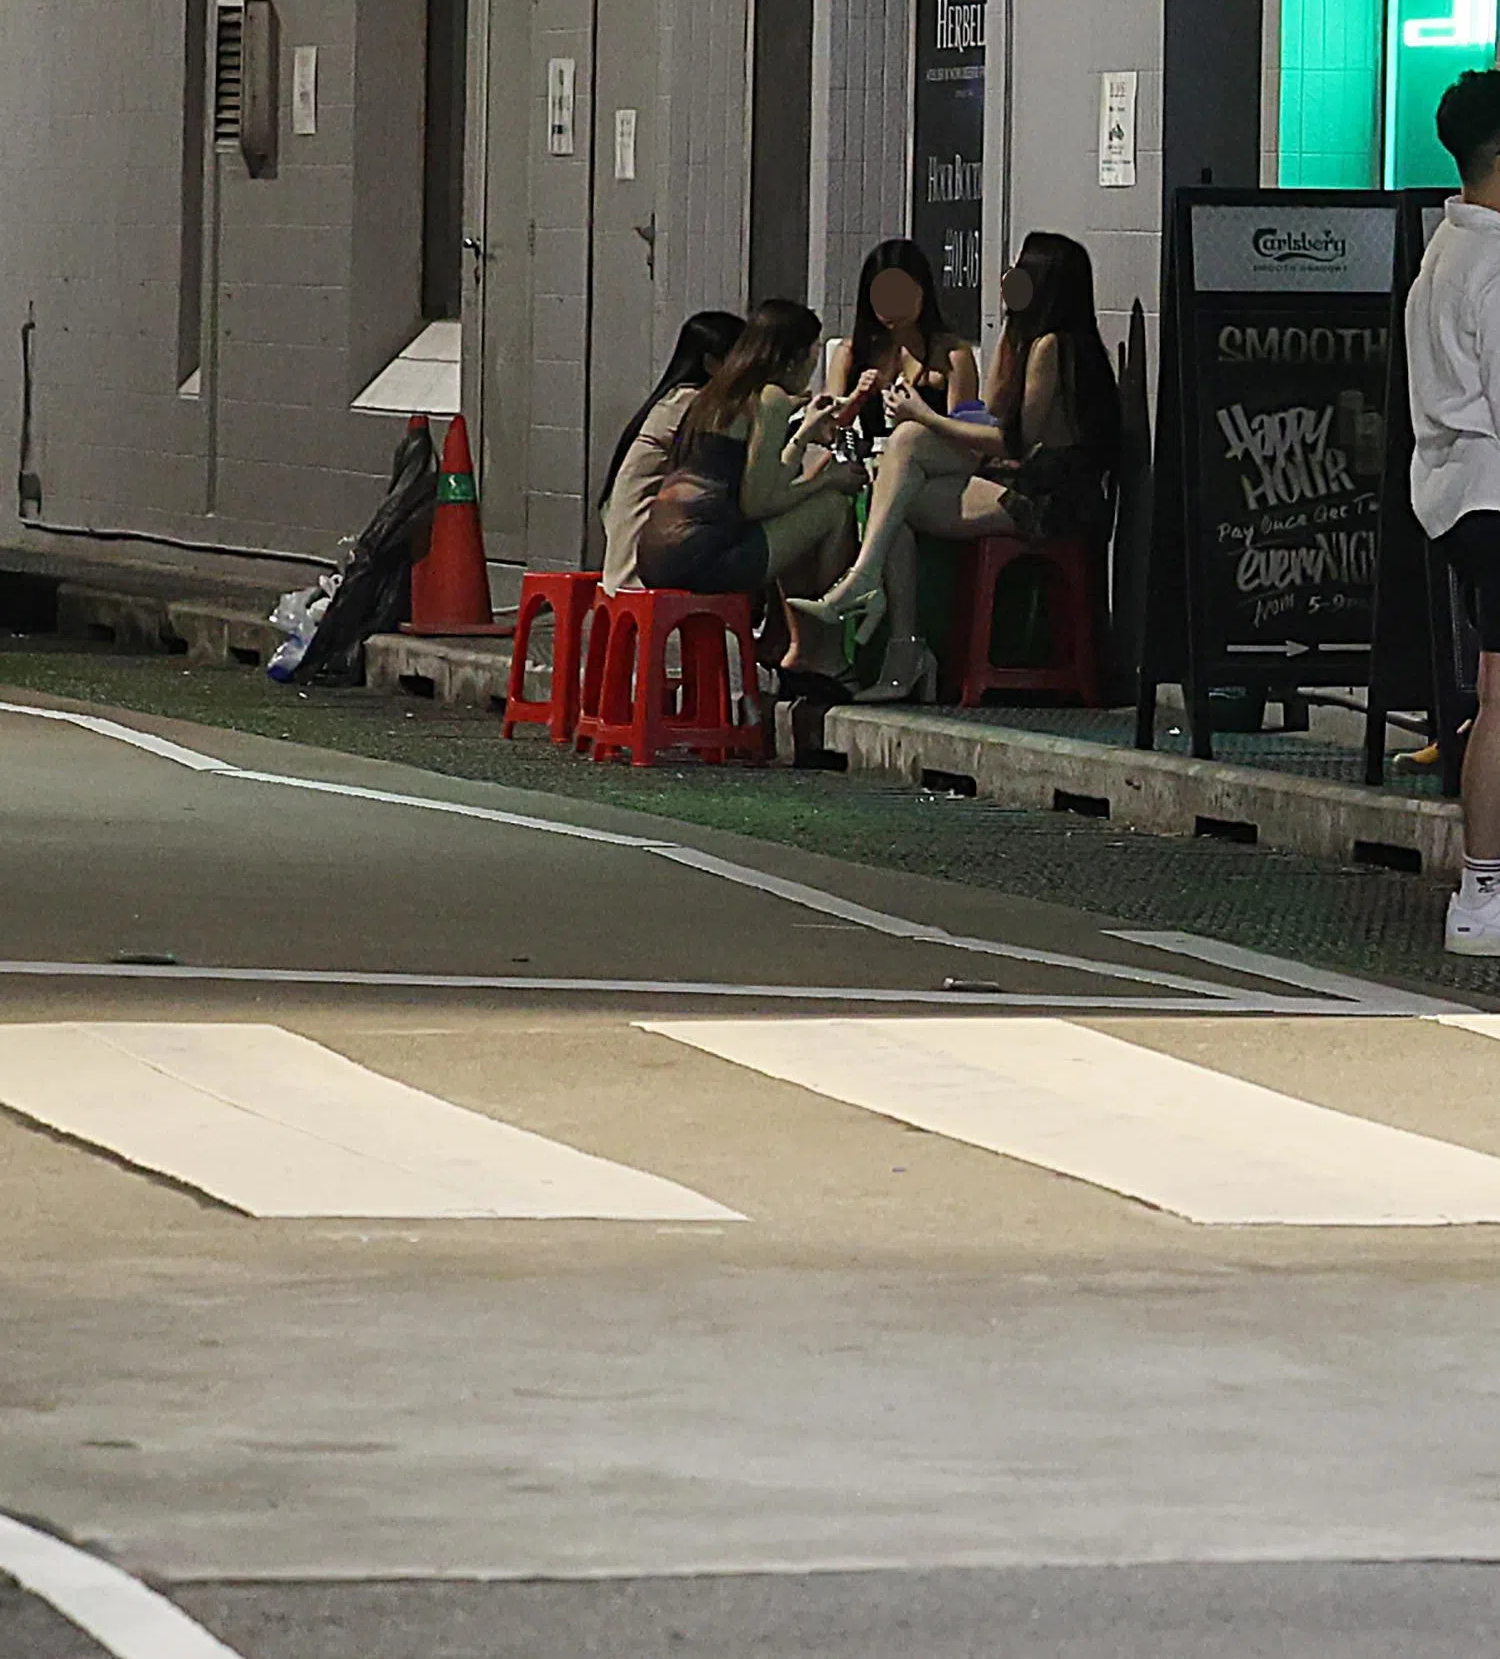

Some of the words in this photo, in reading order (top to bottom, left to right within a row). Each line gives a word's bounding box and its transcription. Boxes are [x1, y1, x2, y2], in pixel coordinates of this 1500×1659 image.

[1252, 227, 1347, 262] Carlsberg
[1217, 325, 1389, 363] SMOOTH
[1216, 403, 1335, 469] Happy
[1216, 521, 1255, 547] Pay
